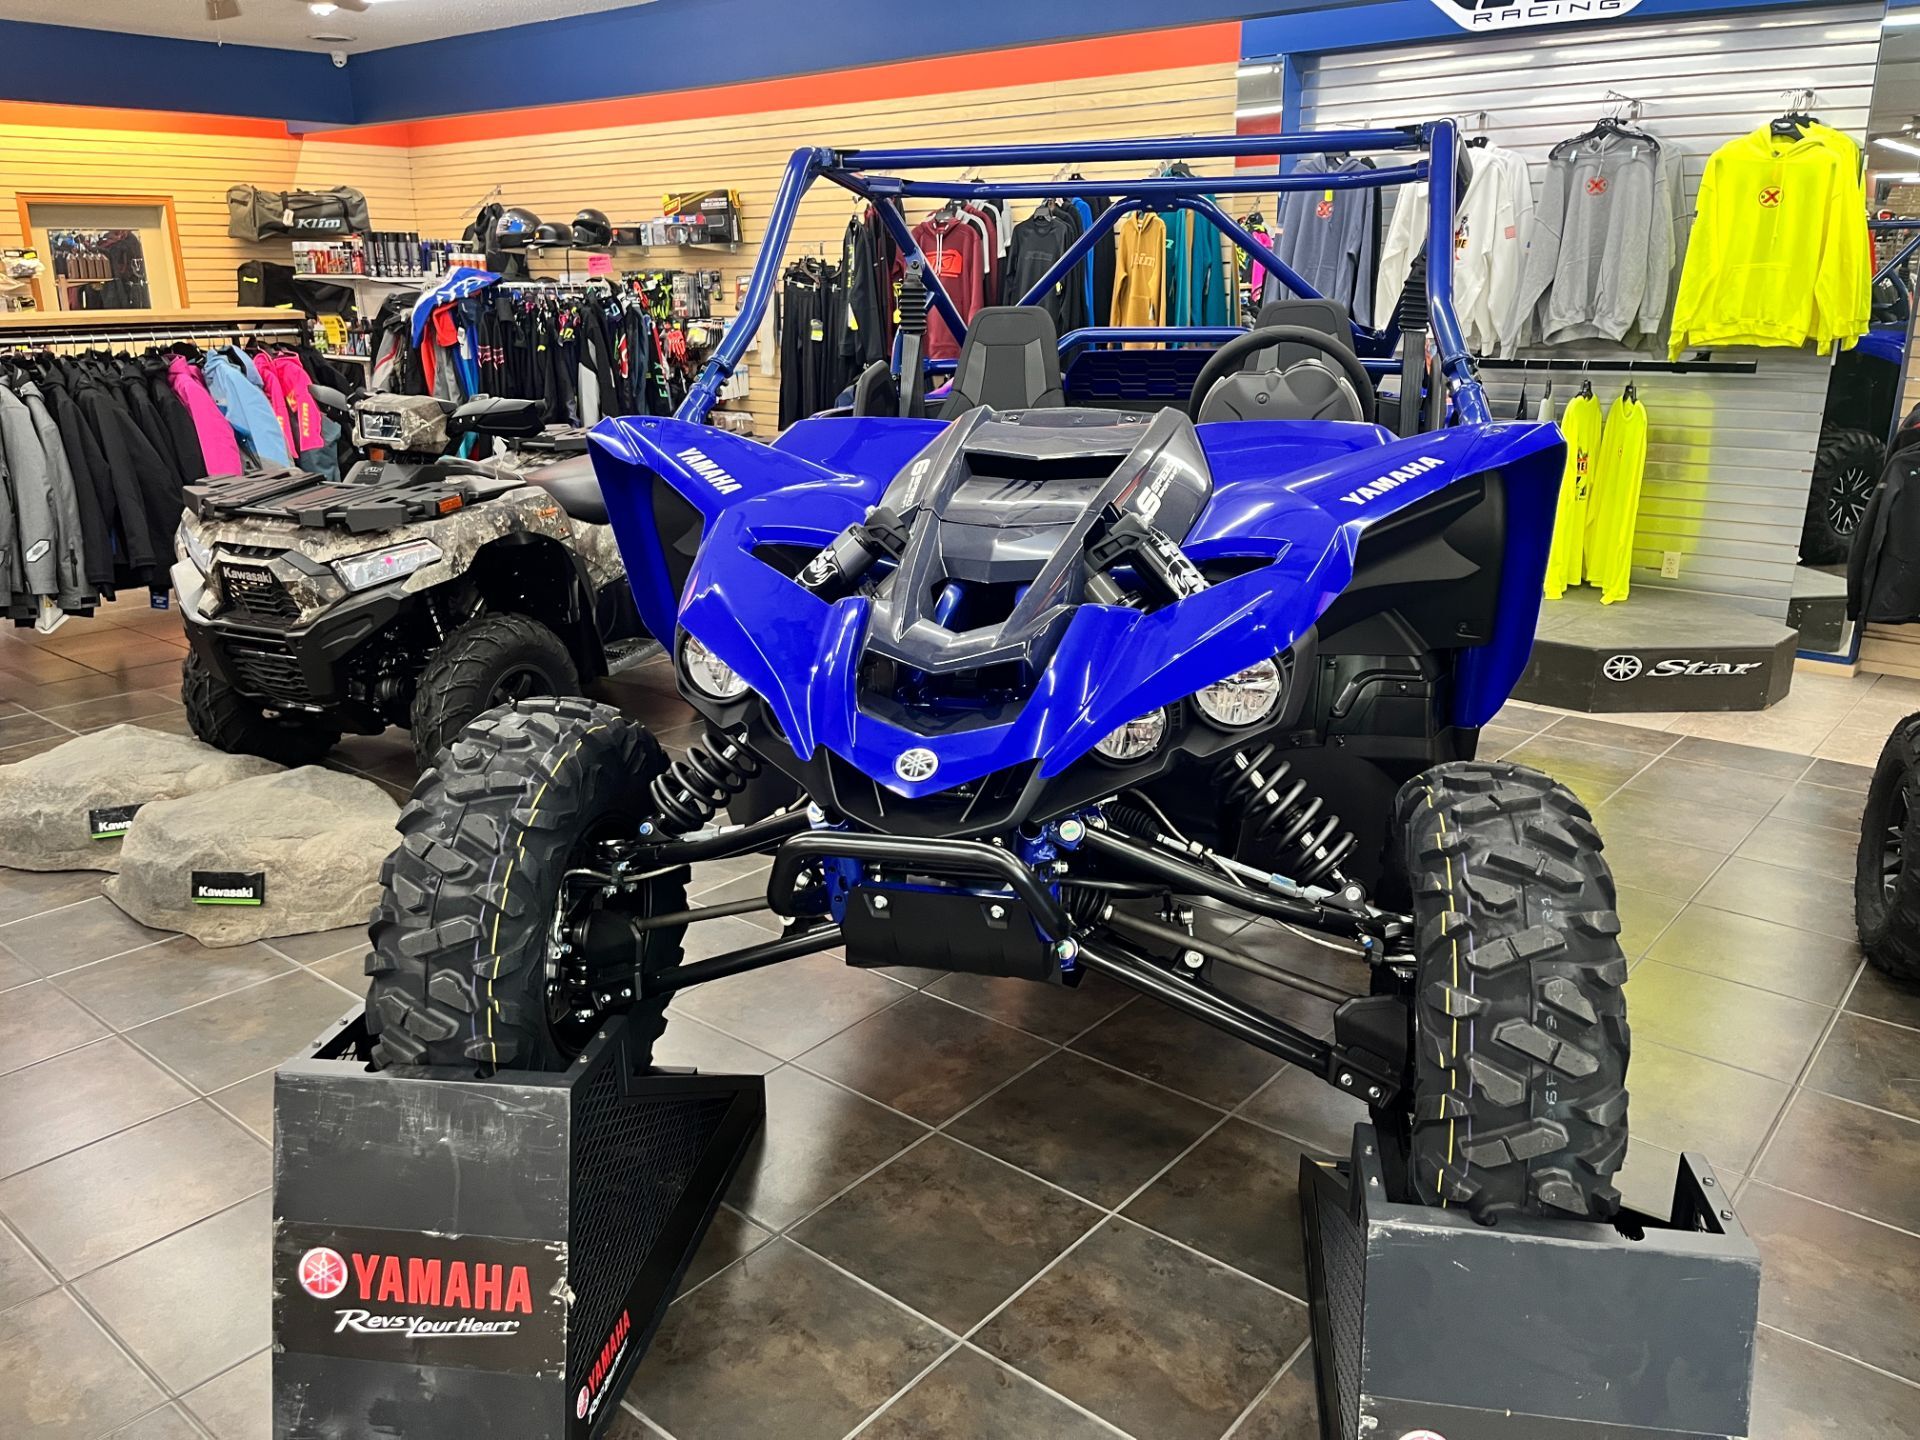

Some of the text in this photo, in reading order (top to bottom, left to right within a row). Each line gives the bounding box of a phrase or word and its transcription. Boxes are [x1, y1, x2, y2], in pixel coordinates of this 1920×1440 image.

[1473, 1, 1621, 25] RACING
[297, 218, 341, 229] Klim
[676, 447, 743, 495] YAMAHA
[1339, 456, 1446, 506] YAMAHA
[222, 566, 273, 584] Kawasaki
[1646, 659, 1763, 677] Star
[199, 886, 254, 898] Kawasaki
[351, 1253, 533, 1314] YAMAHA
[588, 1308, 631, 1395] YAMAHA
